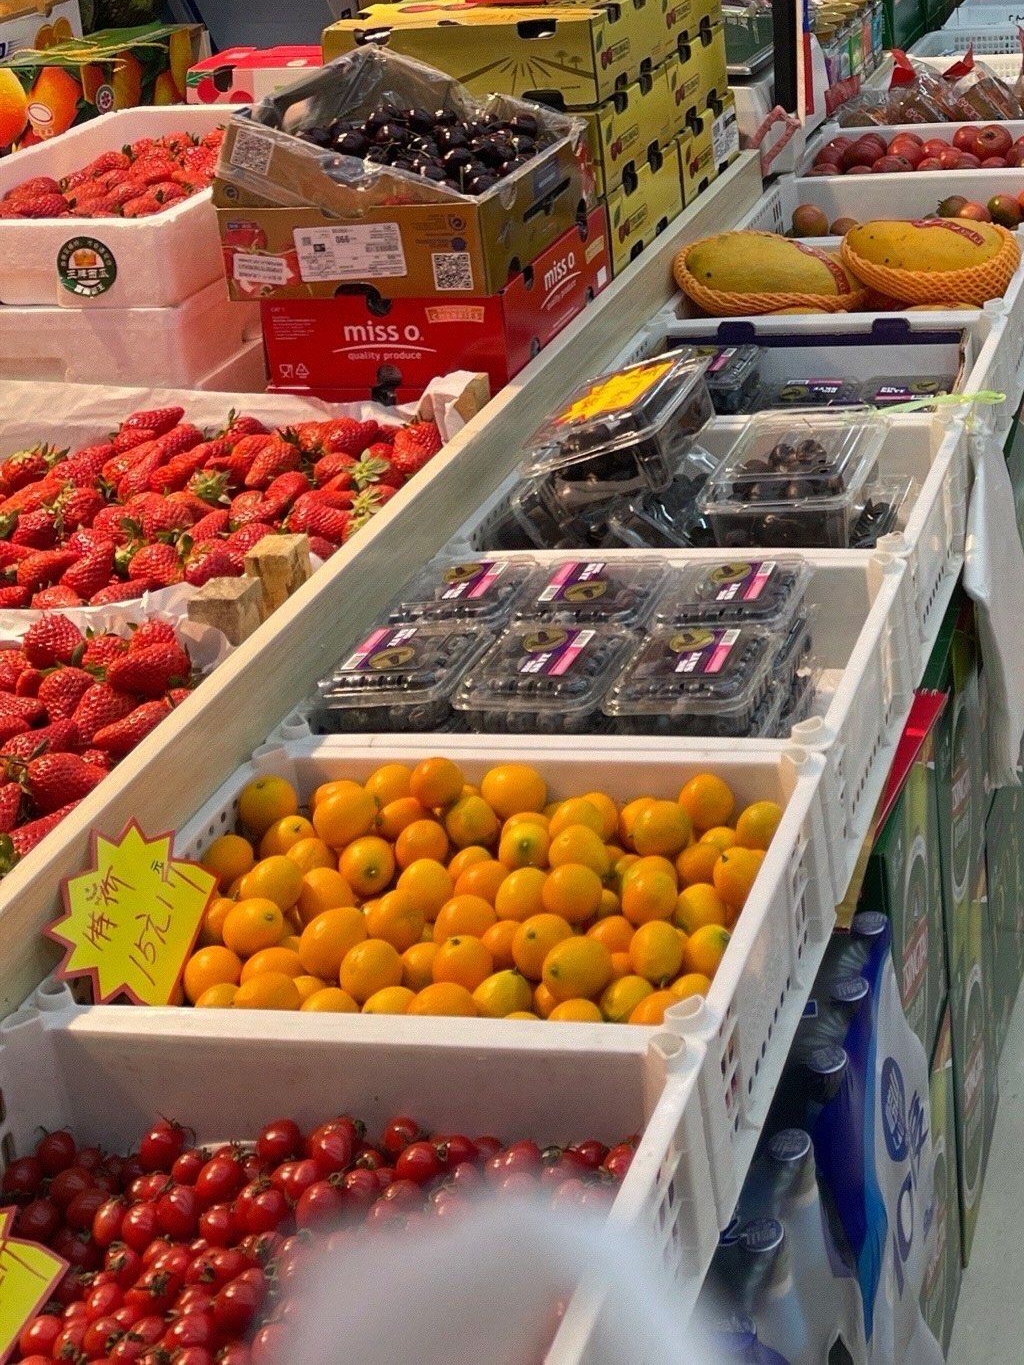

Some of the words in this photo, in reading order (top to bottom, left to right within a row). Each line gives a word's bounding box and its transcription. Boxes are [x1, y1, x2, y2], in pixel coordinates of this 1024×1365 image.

[544, 257, 567, 292] miss
[344, 320, 399, 342] miss
[348, 351, 380, 361] quality
[383, 350, 422, 360] produce
[150, 860, 165, 874] 元
